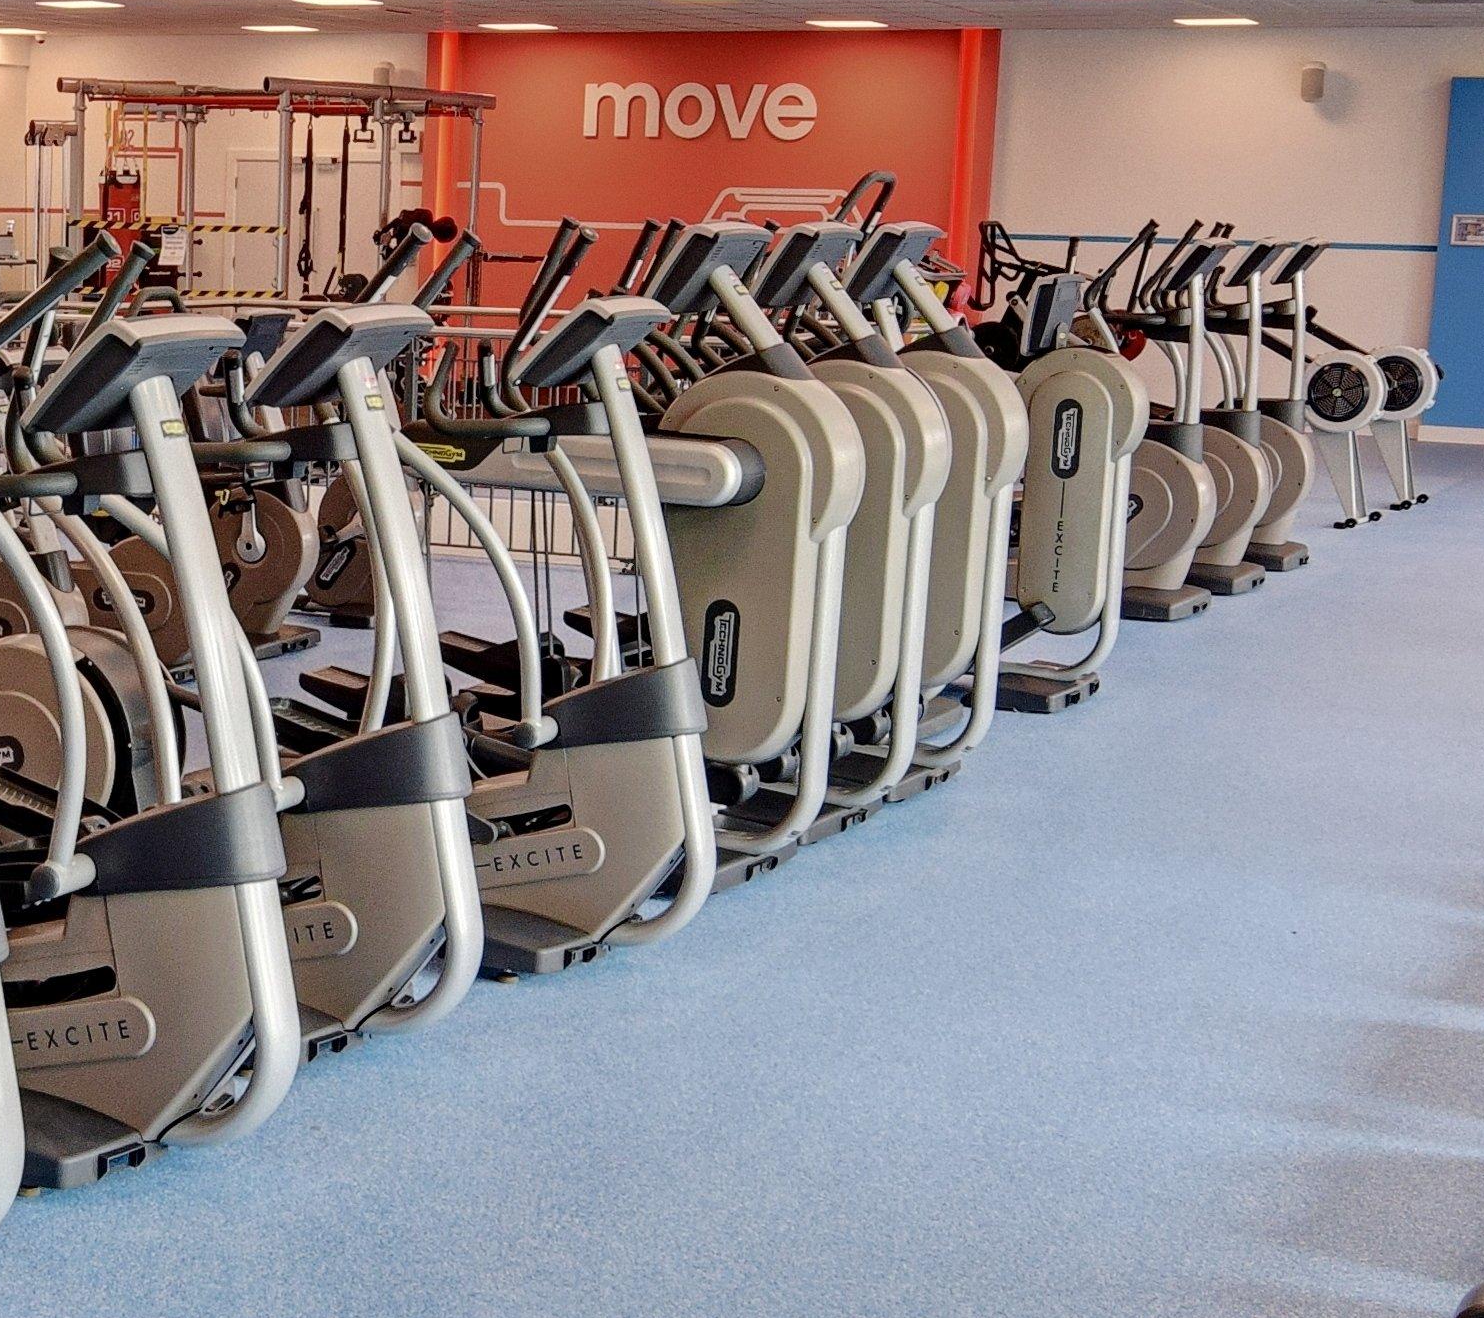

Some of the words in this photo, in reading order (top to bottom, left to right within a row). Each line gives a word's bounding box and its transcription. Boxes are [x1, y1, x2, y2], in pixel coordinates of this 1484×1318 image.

[583, 82, 818, 141] move
[1052, 521, 1064, 592] EXCITE
[713, 614, 732, 692] TECHNOGYM
[493, 844, 583, 872] EXCITE
[294, 922, 335, 944] ITE
[26, 1020, 130, 1051] EXCITE
